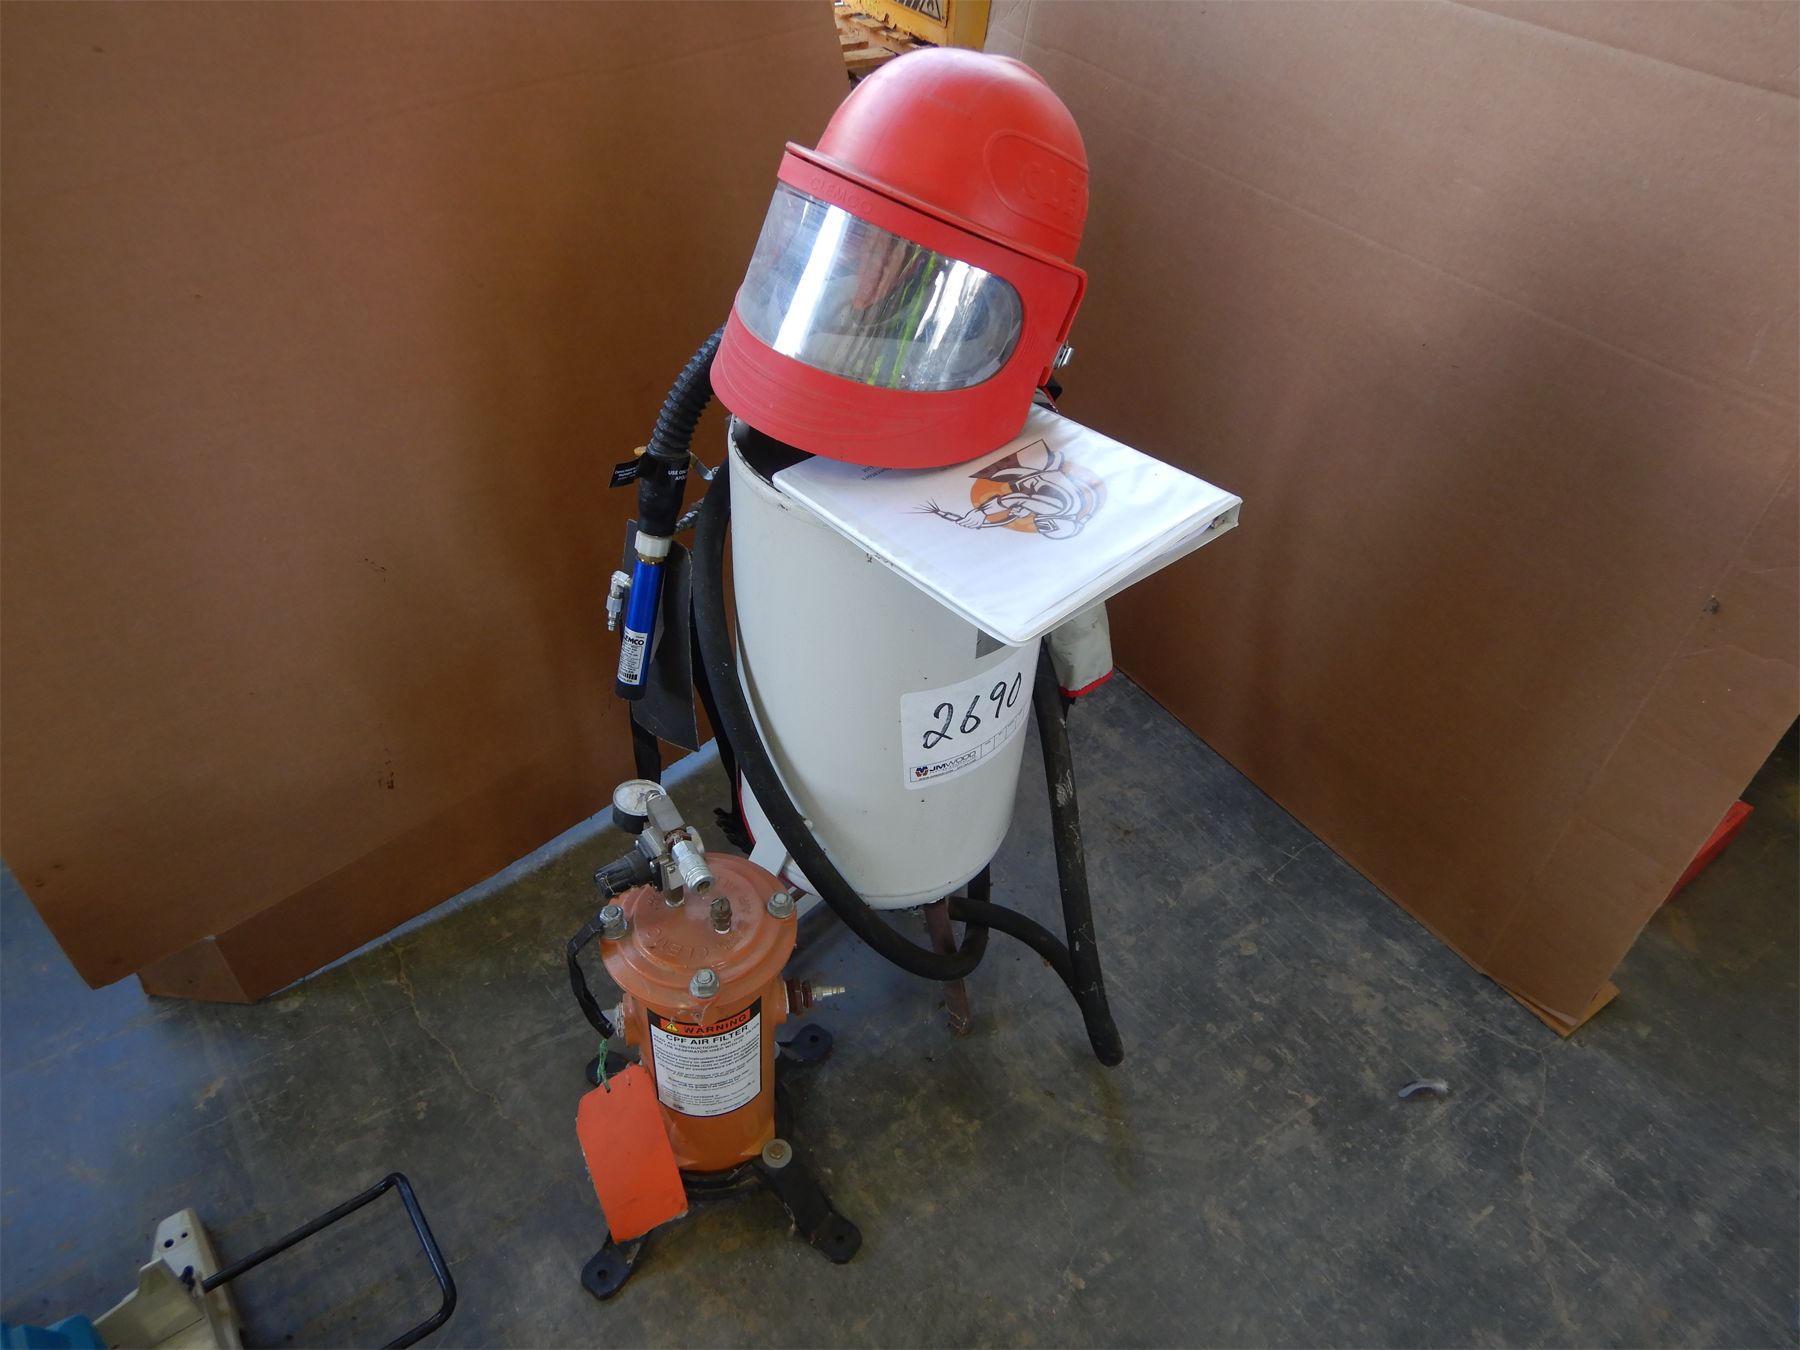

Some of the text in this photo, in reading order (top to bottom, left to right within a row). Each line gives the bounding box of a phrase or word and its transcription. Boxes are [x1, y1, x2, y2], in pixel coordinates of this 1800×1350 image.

[809, 177, 873, 215] CLEMCO
[922, 671, 1022, 750] 2690
[665, 1024, 749, 1045] CPF AIR FILTER
[684, 1013, 748, 1034] WARNING
